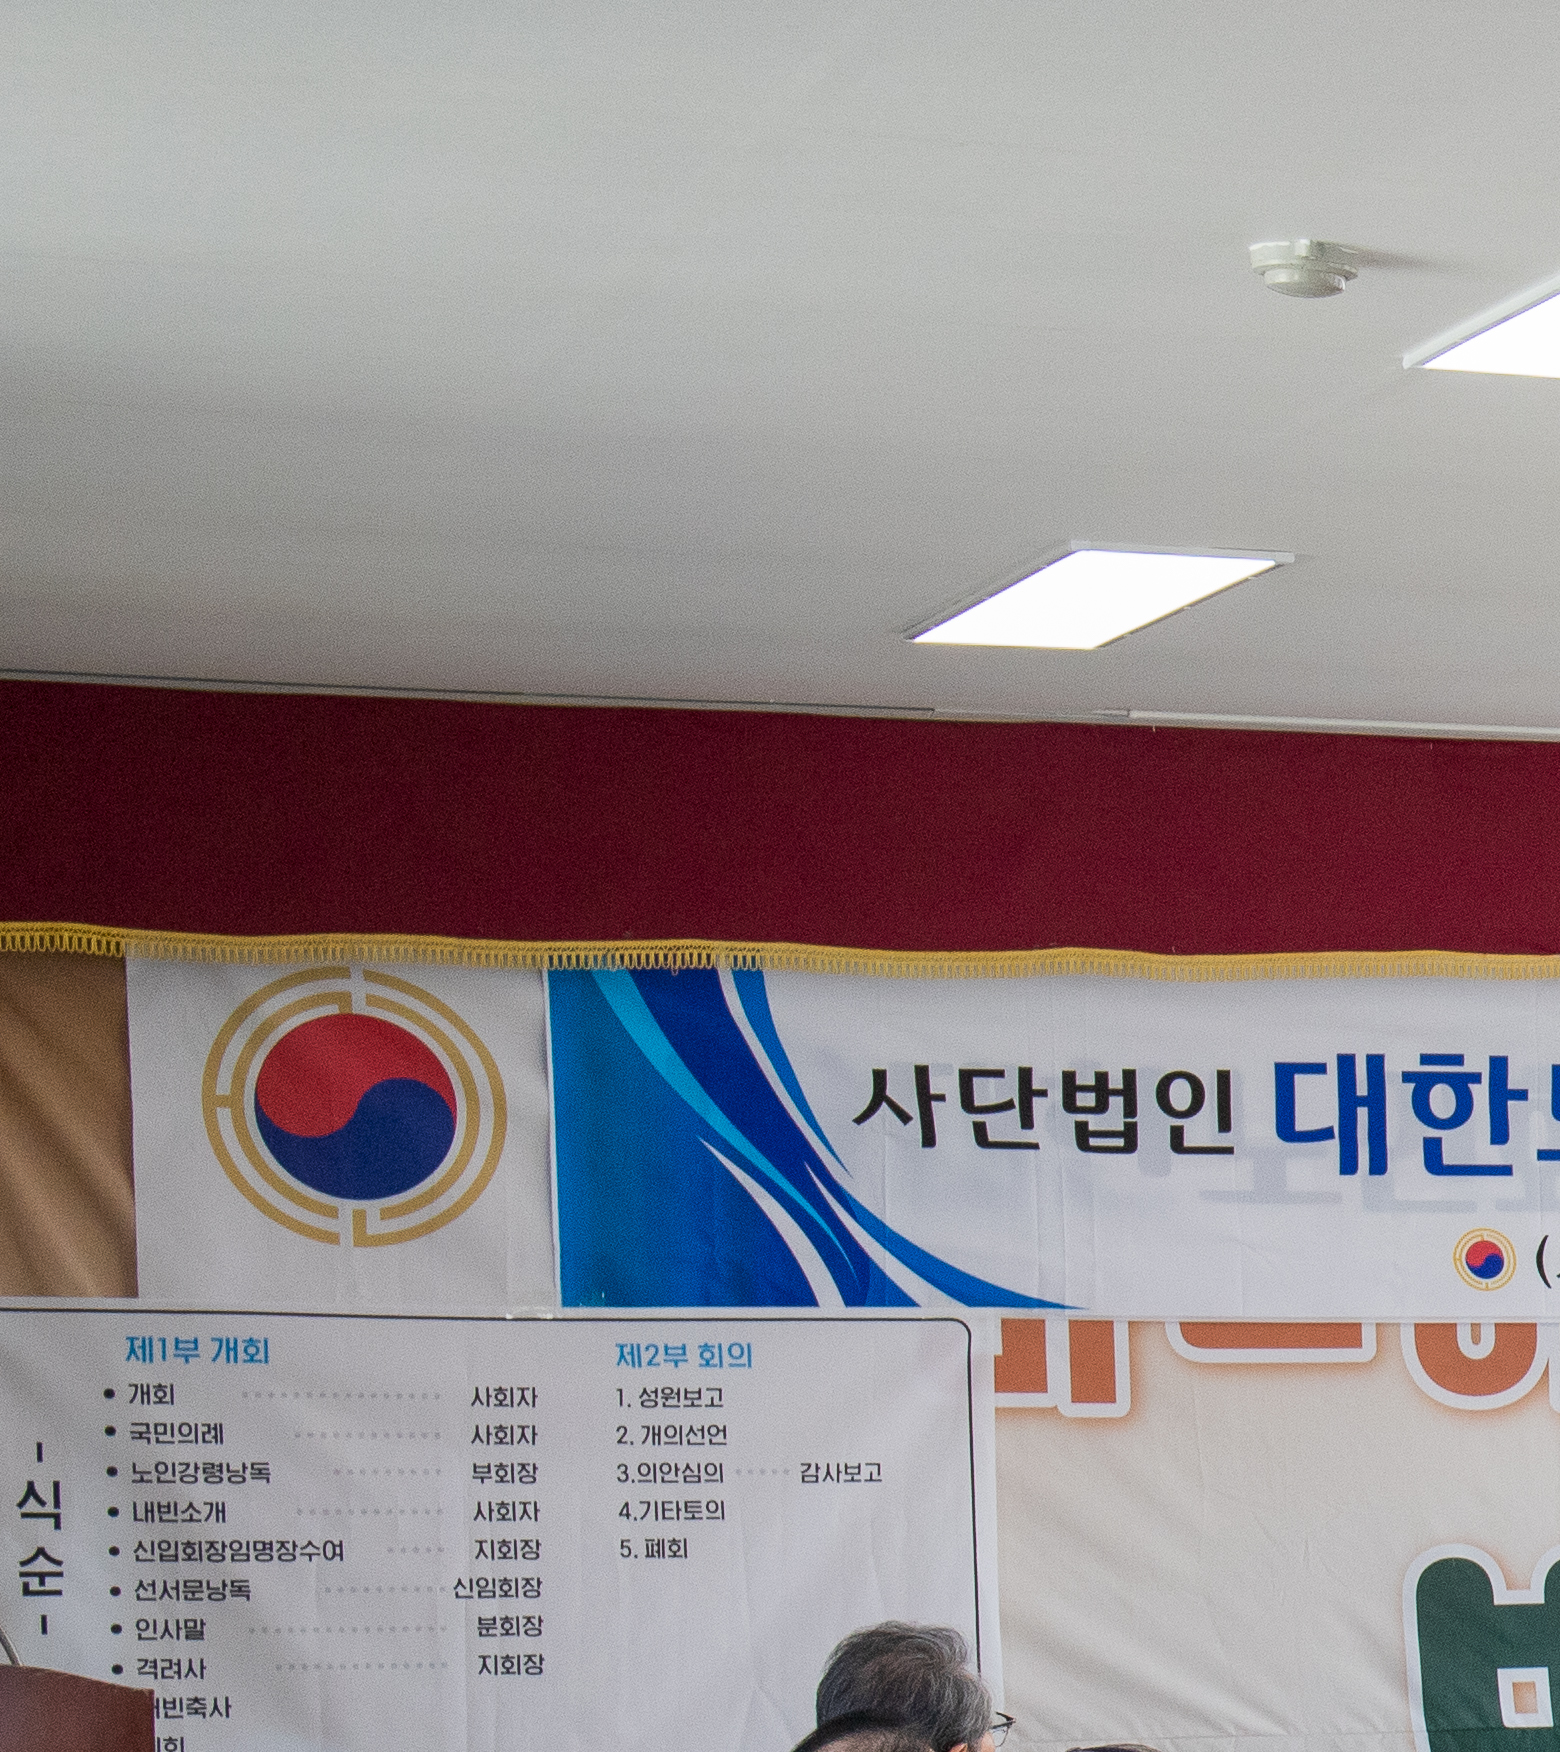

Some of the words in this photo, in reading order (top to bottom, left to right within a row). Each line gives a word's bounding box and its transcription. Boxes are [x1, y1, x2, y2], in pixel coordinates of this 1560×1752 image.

[852, 1063, 1235, 1156] 사단법인
[125, 1335, 201, 1365] 제1부
[210, 1336, 270, 1365] 개회
[615, 1342, 689, 1369] 제2부
[697, 1341, 753, 1369] 회의
[128, 1383, 175, 1406] 개회
[470, 1386, 539, 1409] 사회자
[616, 1387, 632, 1408] 1.
[638, 1386, 725, 1409] 성원보고
[129, 1422, 225, 1445] 국민의례
[470, 1424, 539, 1446] 사회자
[615, 1425, 635, 1446] 2.
[641, 1424, 728, 1446] 개의선언
[131, 1461, 272, 1485] 노인강령낭독
[472, 1462, 539, 1485] 부회장
[800, 1462, 883, 1484] 감사보고
[132, 1501, 227, 1524] 내빈소개
[473, 1500, 541, 1522] 사회자
[474, 1538, 542, 1561] 지회장
[619, 1538, 639, 1559] 5.
[644, 1537, 689, 1560] 폐회
[134, 1579, 252, 1602] 선서문낭독
[453, 1576, 543, 1600] 신임회장
[135, 1618, 207, 1641] 인사말
[476, 1614, 544, 1638] 분회장
[136, 1657, 207, 1680] 격려사
[477, 1654, 545, 1676] 지회장
